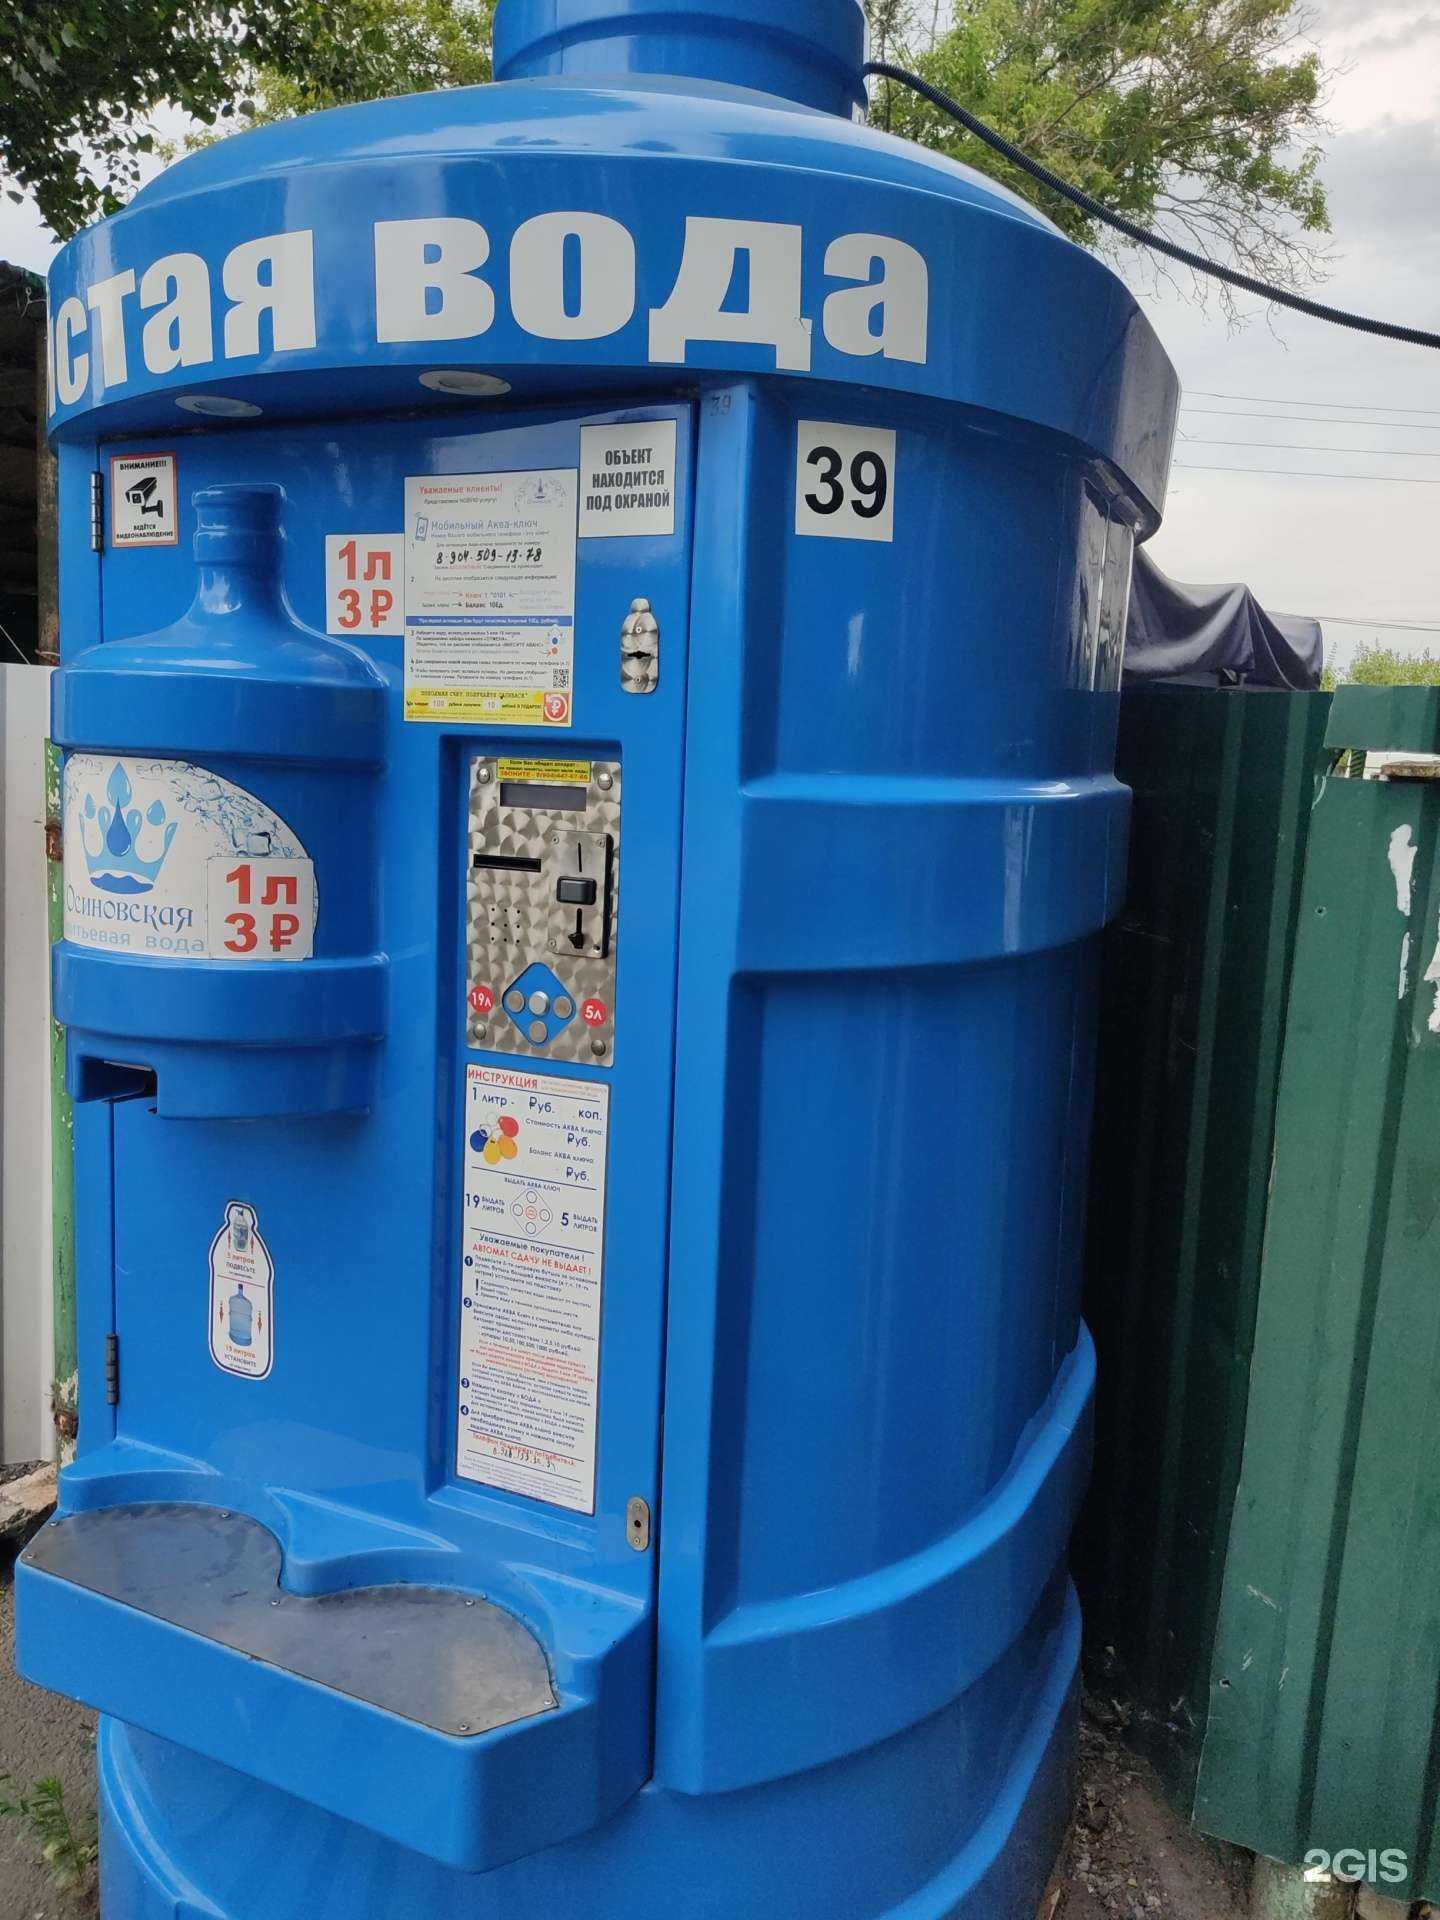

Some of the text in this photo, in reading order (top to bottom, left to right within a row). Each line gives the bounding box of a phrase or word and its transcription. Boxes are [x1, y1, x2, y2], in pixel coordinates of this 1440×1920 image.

[48, 210, 930, 418] стая вода
[605, 448, 652, 466] ОБЪЕКТ
[419, 482, 502, 495] Уважаемые клиенты!
[592, 470, 665, 489] НАХОДИТСЯ
[805, 446, 887, 518] 39
[586, 494, 612, 512] ПОД
[614, 489, 670, 508] ОХРАНОЙ
[431, 519, 483, 531] Мобильный
[145, 935, 205, 954] вода
[468, 1069, 537, 1089] ИНСТРУКЦИЯ
[472, 1087, 476, 1100] 1
[482, 1093, 507, 1107] литр
[578, 1108, 602, 1120] коп.
[465, 1192, 480, 1208] 19
[560, 1211, 569, 1226] 5
[472, 1243, 508, 1258] АВТОМАТ
[511, 1251, 538, 1264] СДАЧУ
[542, 1257, 552, 1267] НЕ
[554, 1260, 586, 1274] ВЫДАЕТ
[479, 1233, 527, 1251] Уважаемые
[530, 1244, 579, 1262] покупатели
